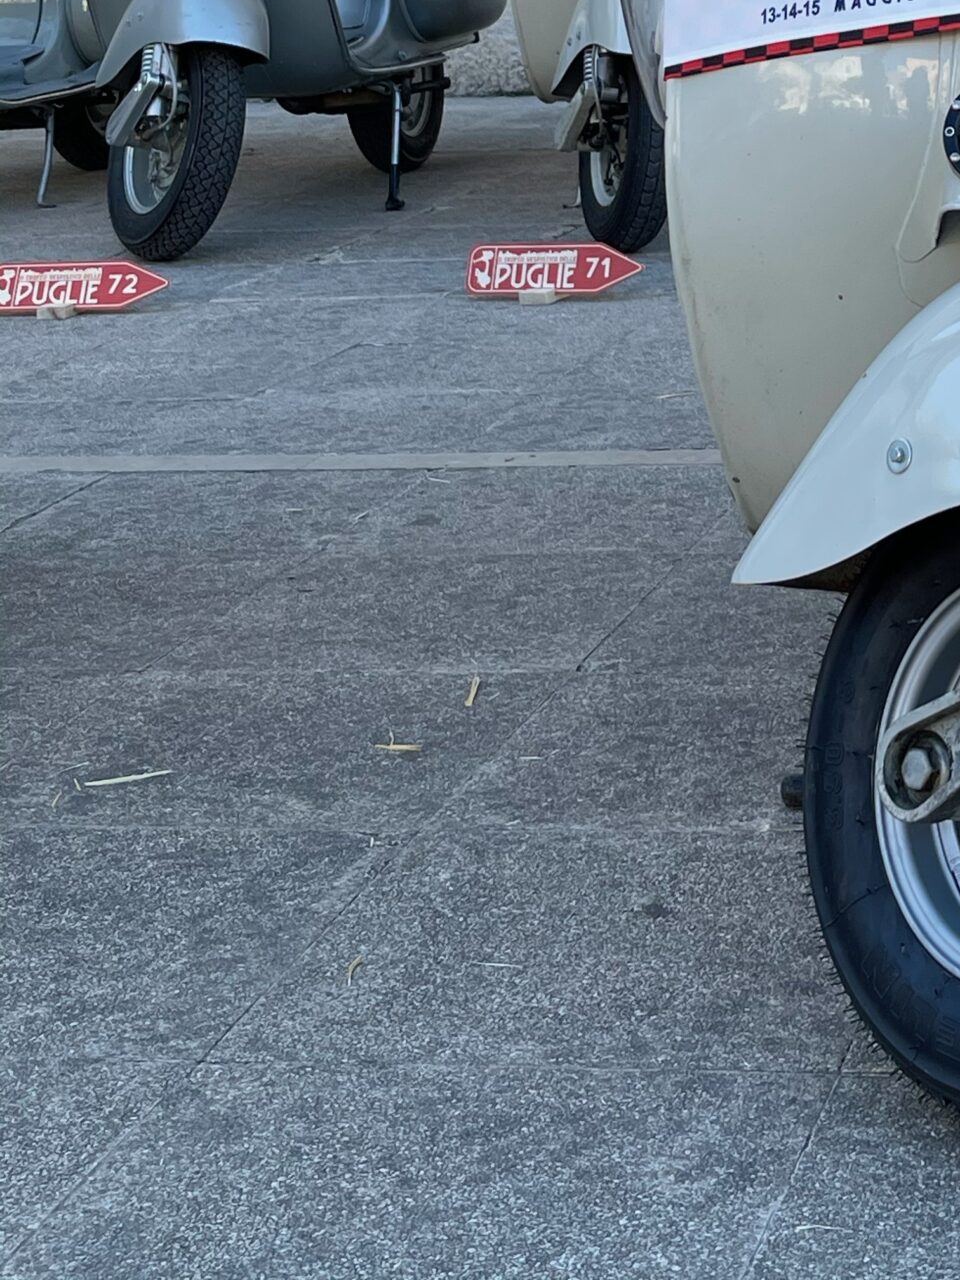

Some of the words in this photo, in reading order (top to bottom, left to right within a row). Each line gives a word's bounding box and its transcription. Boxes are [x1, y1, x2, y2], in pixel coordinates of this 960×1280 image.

[761, 0, 820, 25] 13-14-15
[495, 263, 577, 288] PUGLIE
[586, 257, 611, 278] 71
[15, 280, 100, 305] PUGLIE
[108, 274, 138, 294] 72
